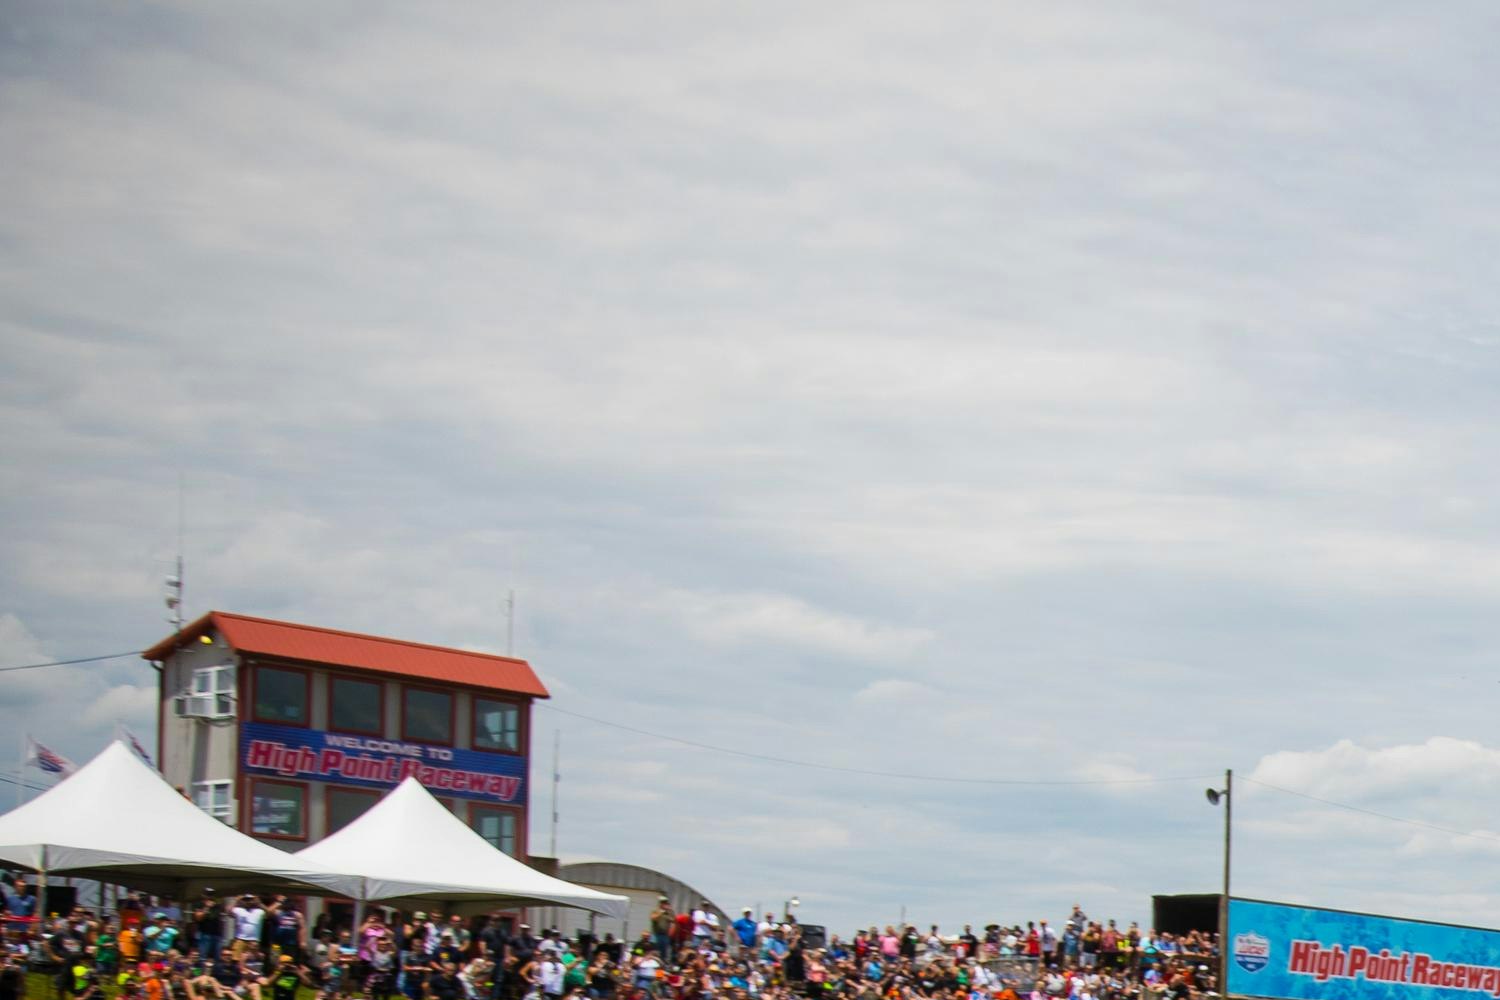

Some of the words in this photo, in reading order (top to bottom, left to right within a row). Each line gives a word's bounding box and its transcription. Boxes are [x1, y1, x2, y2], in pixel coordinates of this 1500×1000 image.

[326, 734, 424, 757] WELCOME
[429, 747, 453, 761] TO
[248, 739, 318, 776] High
[319, 749, 396, 784] Point
[399, 758, 521, 801] Raceway
[1289, 941, 1346, 981] High
[1347, 945, 1409, 983] Point
